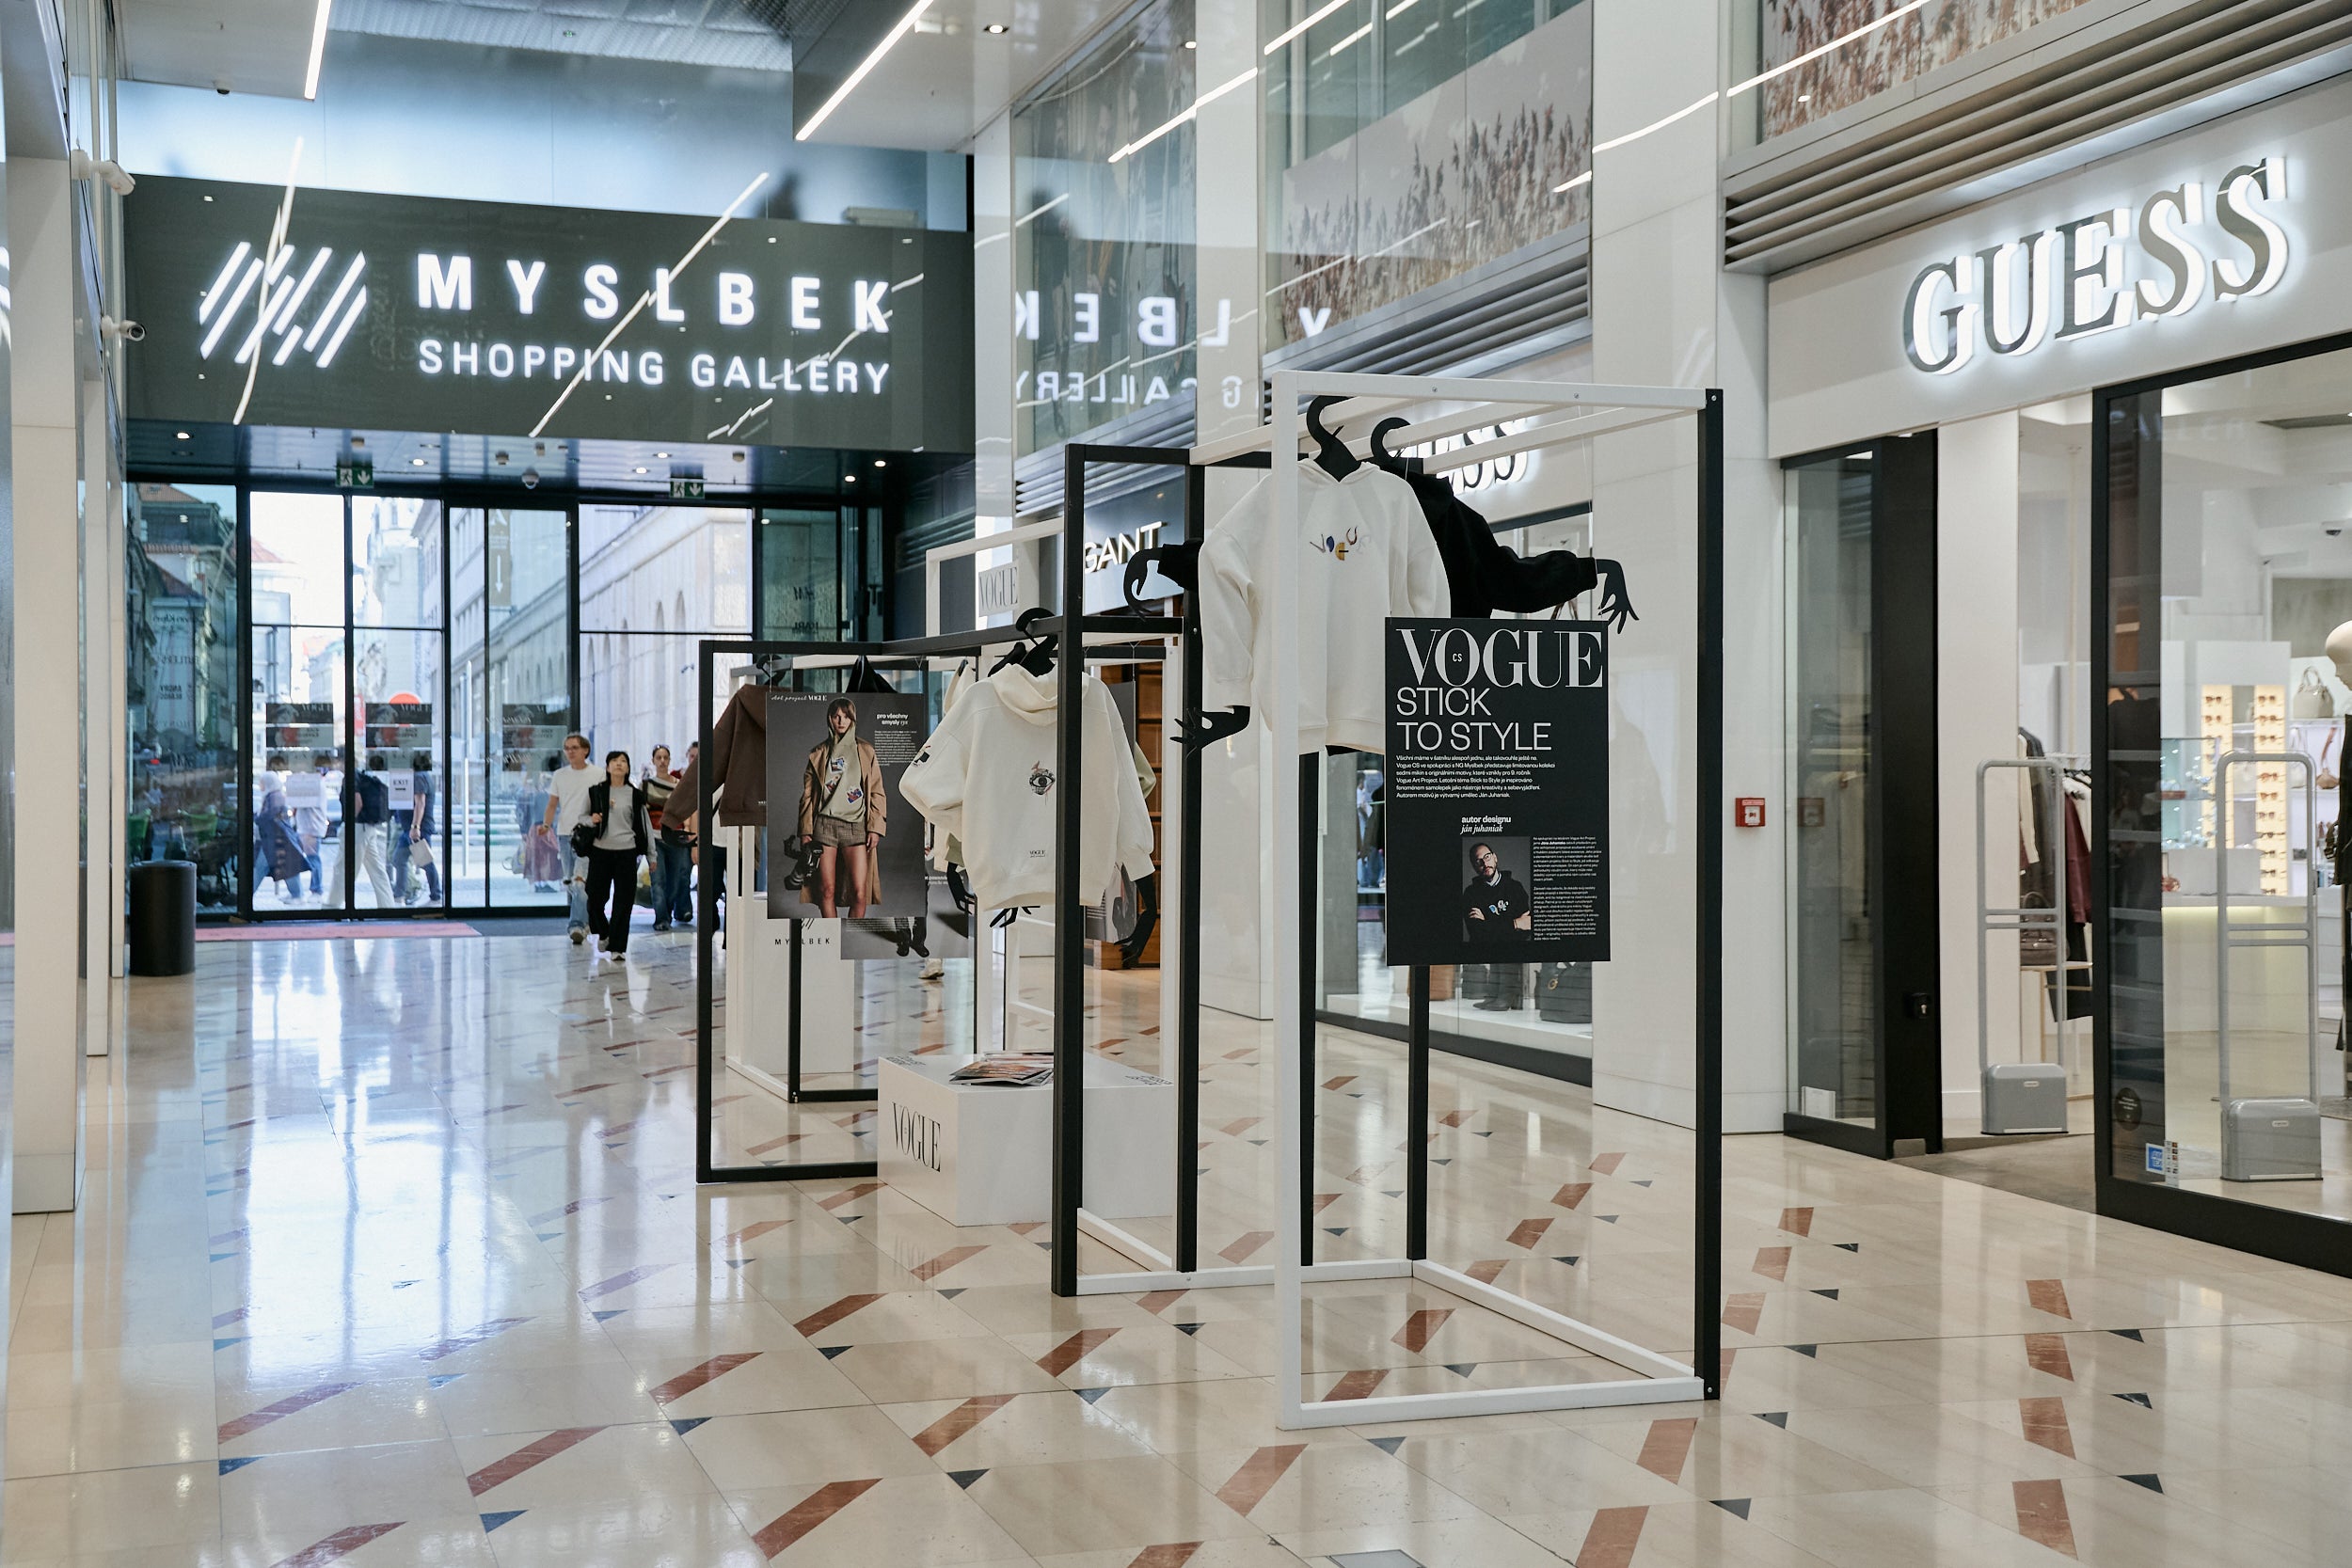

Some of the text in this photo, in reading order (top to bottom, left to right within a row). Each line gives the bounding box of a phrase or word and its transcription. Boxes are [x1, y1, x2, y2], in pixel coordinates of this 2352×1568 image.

[1902, 155, 2289, 375] GUESS
[417, 253, 890, 333] MYSLBEK
[419, 338, 890, 395] SHOPPING GALLERY
[1085, 521, 1163, 575] GANT
[979, 567, 1019, 610] VOGUE
[1395, 628, 1603, 689] VOGUE
[1396, 687, 1492, 716] STICK
[1396, 721, 1552, 751] TO STYLE
[1460, 824, 1503, 834] ján juhaniak
[1483, 816, 1511, 824] designu
[892, 1101, 941, 1173] VOGUE
